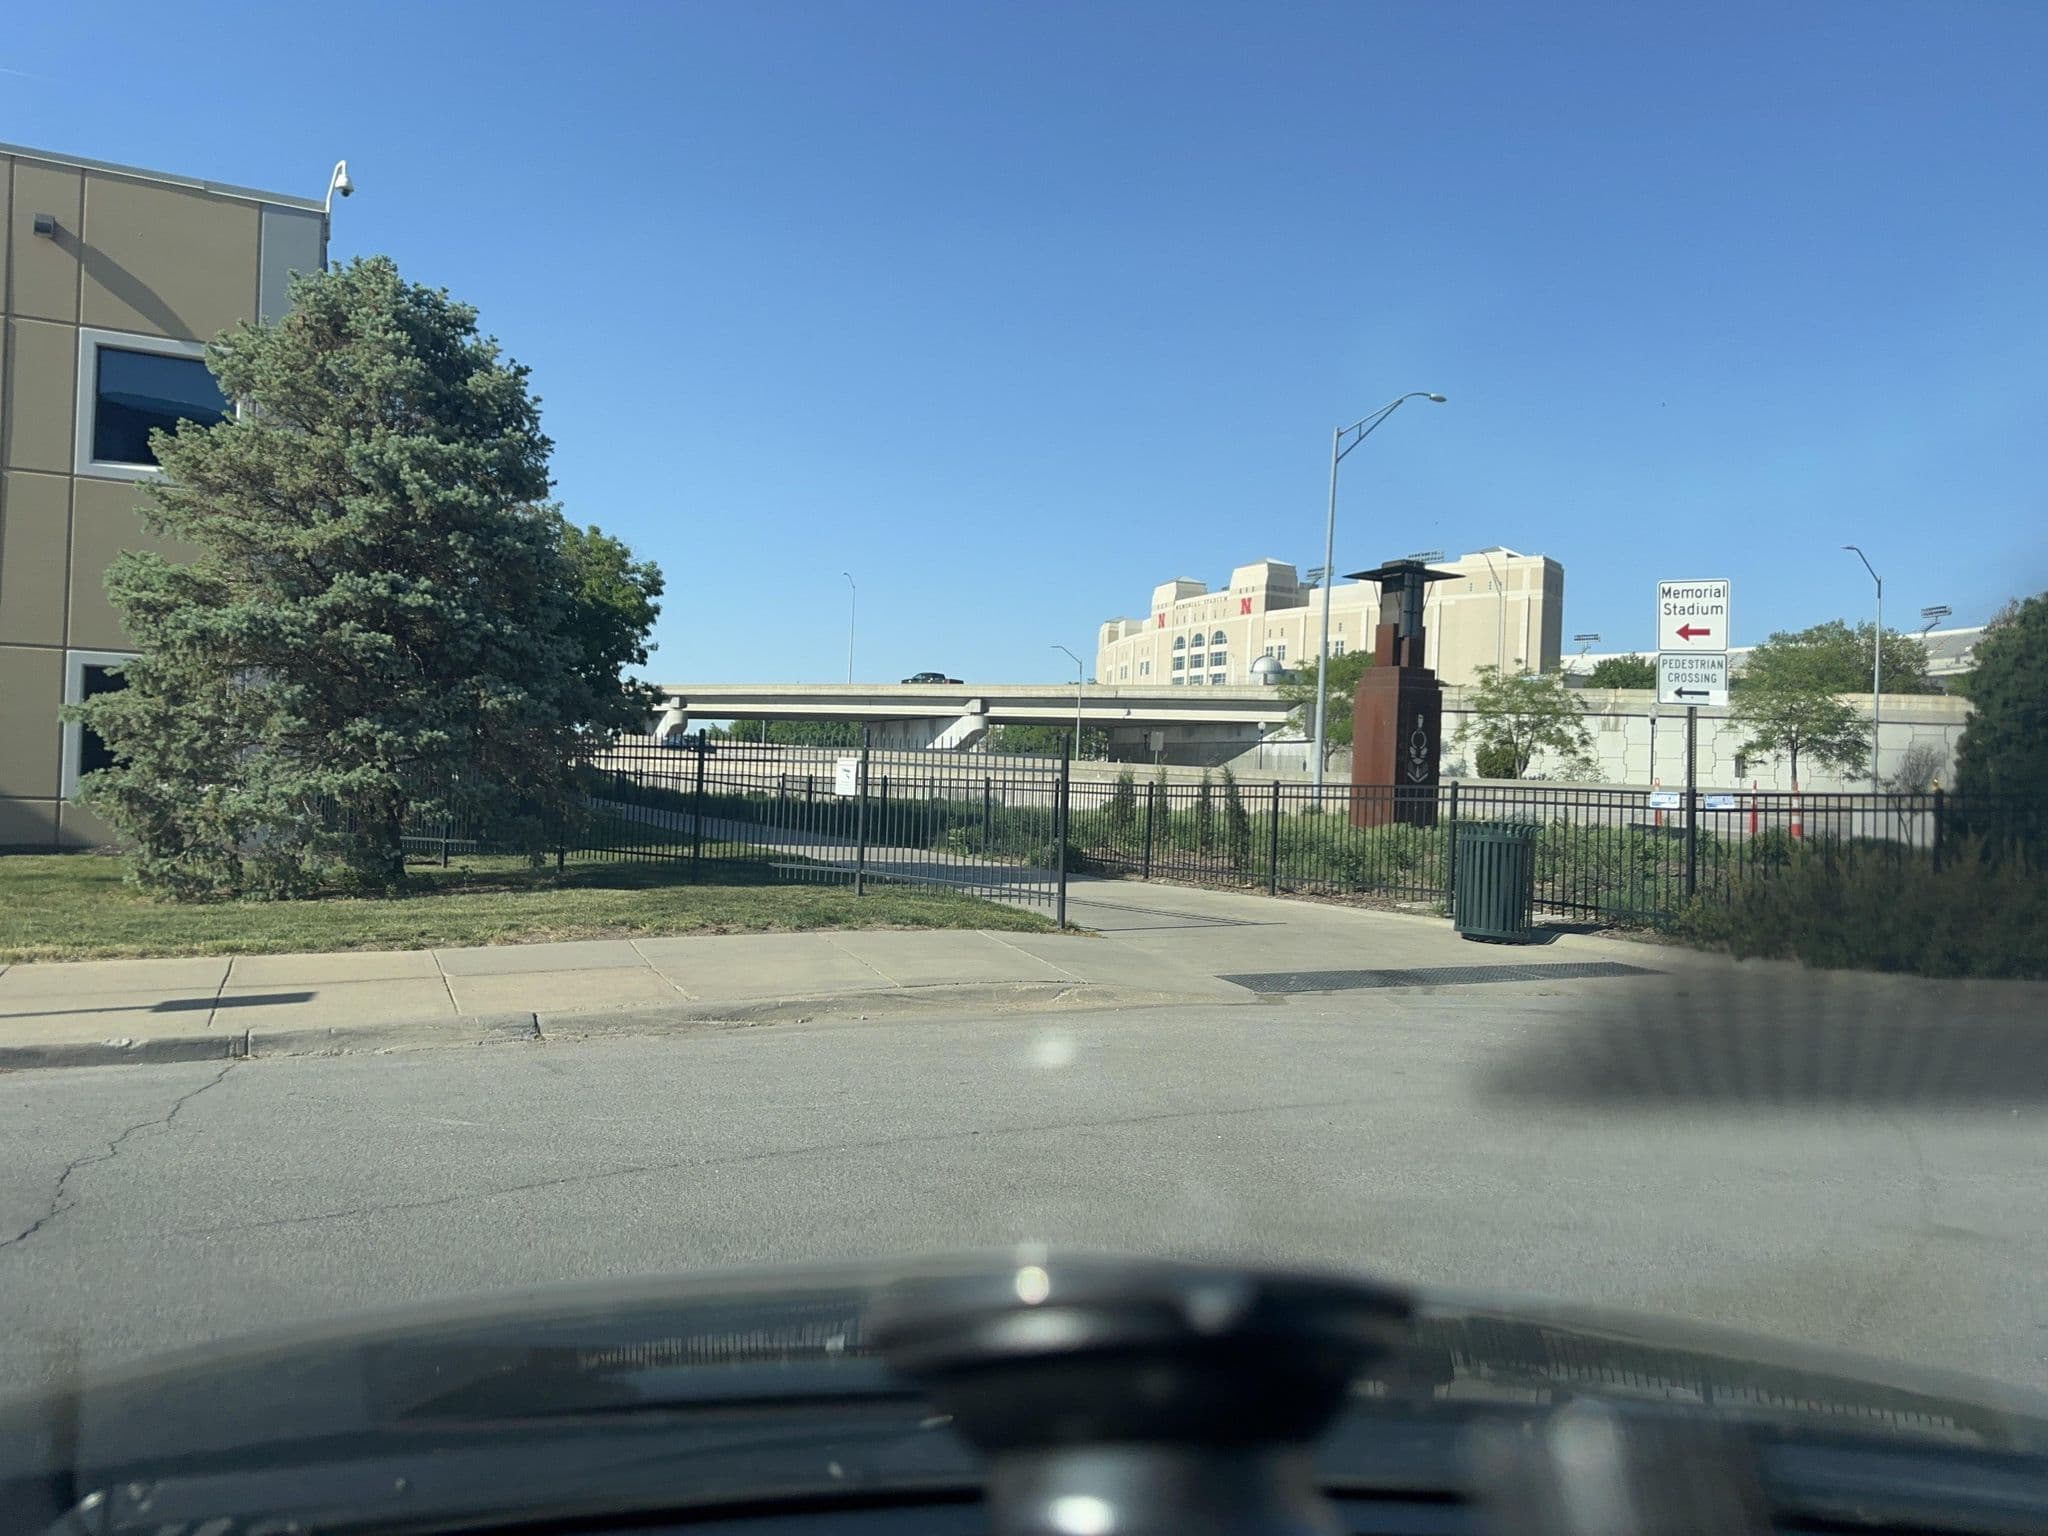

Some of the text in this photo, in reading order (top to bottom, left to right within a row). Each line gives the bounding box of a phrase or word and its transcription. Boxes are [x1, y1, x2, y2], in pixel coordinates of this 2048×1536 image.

[1661, 585, 1726, 599] Memorial
[1241, 597, 1252, 615] N
[1663, 602, 1724, 616] Stadium
[1158, 612, 1166, 629] N
[1661, 658, 1724, 670] PEDESTRIAN
[1667, 672, 1717, 684] CROSSING
